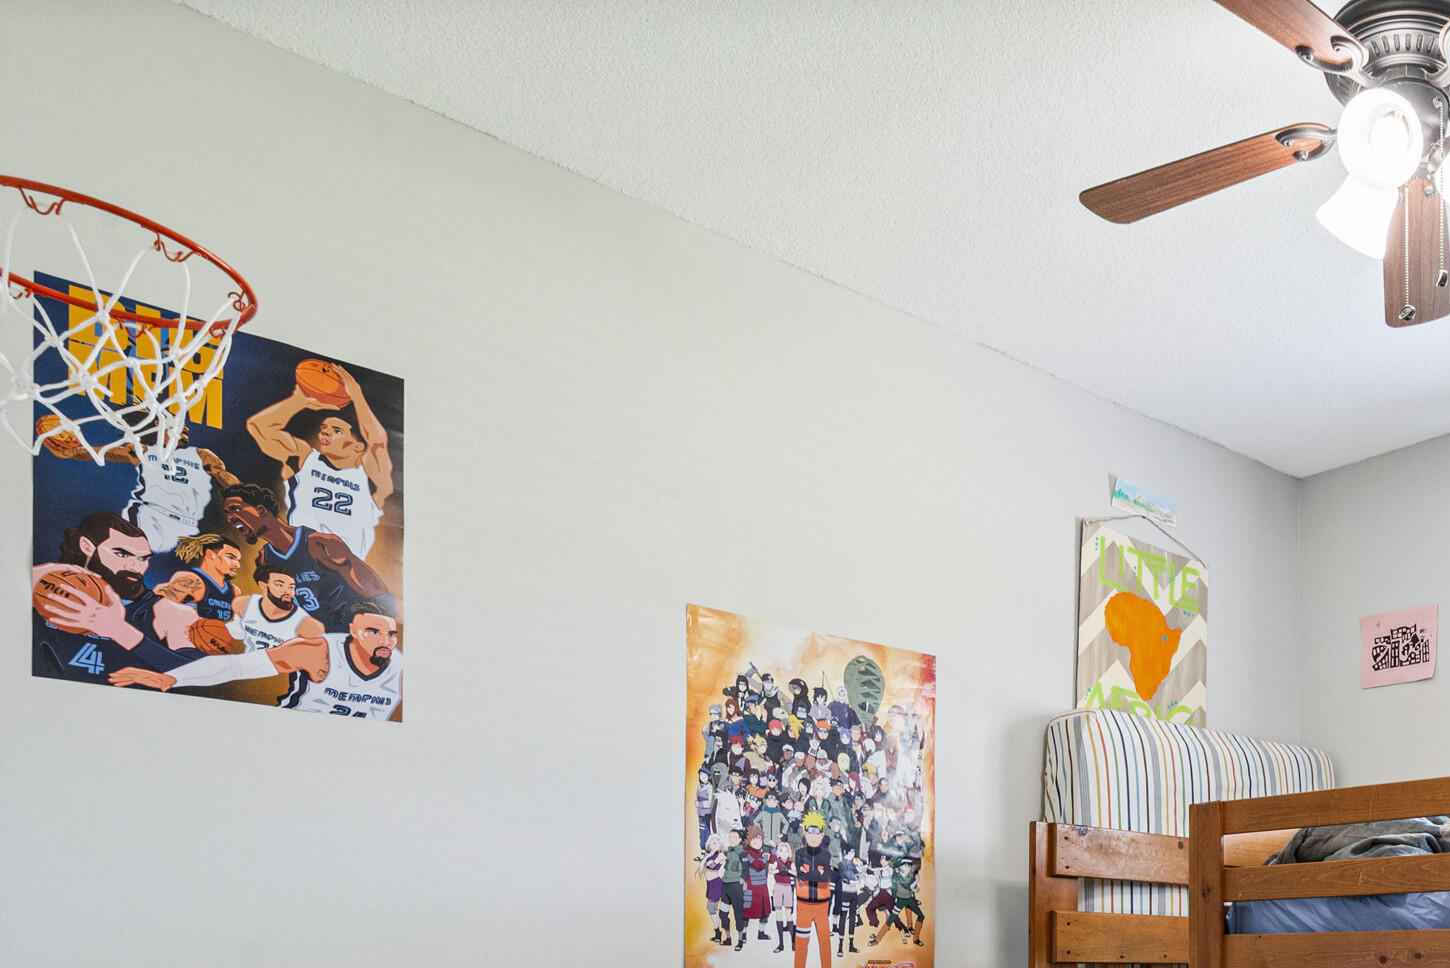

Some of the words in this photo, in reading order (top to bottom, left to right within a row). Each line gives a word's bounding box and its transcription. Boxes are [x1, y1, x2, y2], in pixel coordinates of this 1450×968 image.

[312, 487, 353, 516] 22
[1099, 536, 1200, 613] LITTLE
[216, 609, 232, 620] 15
[68, 642, 105, 675] 4
